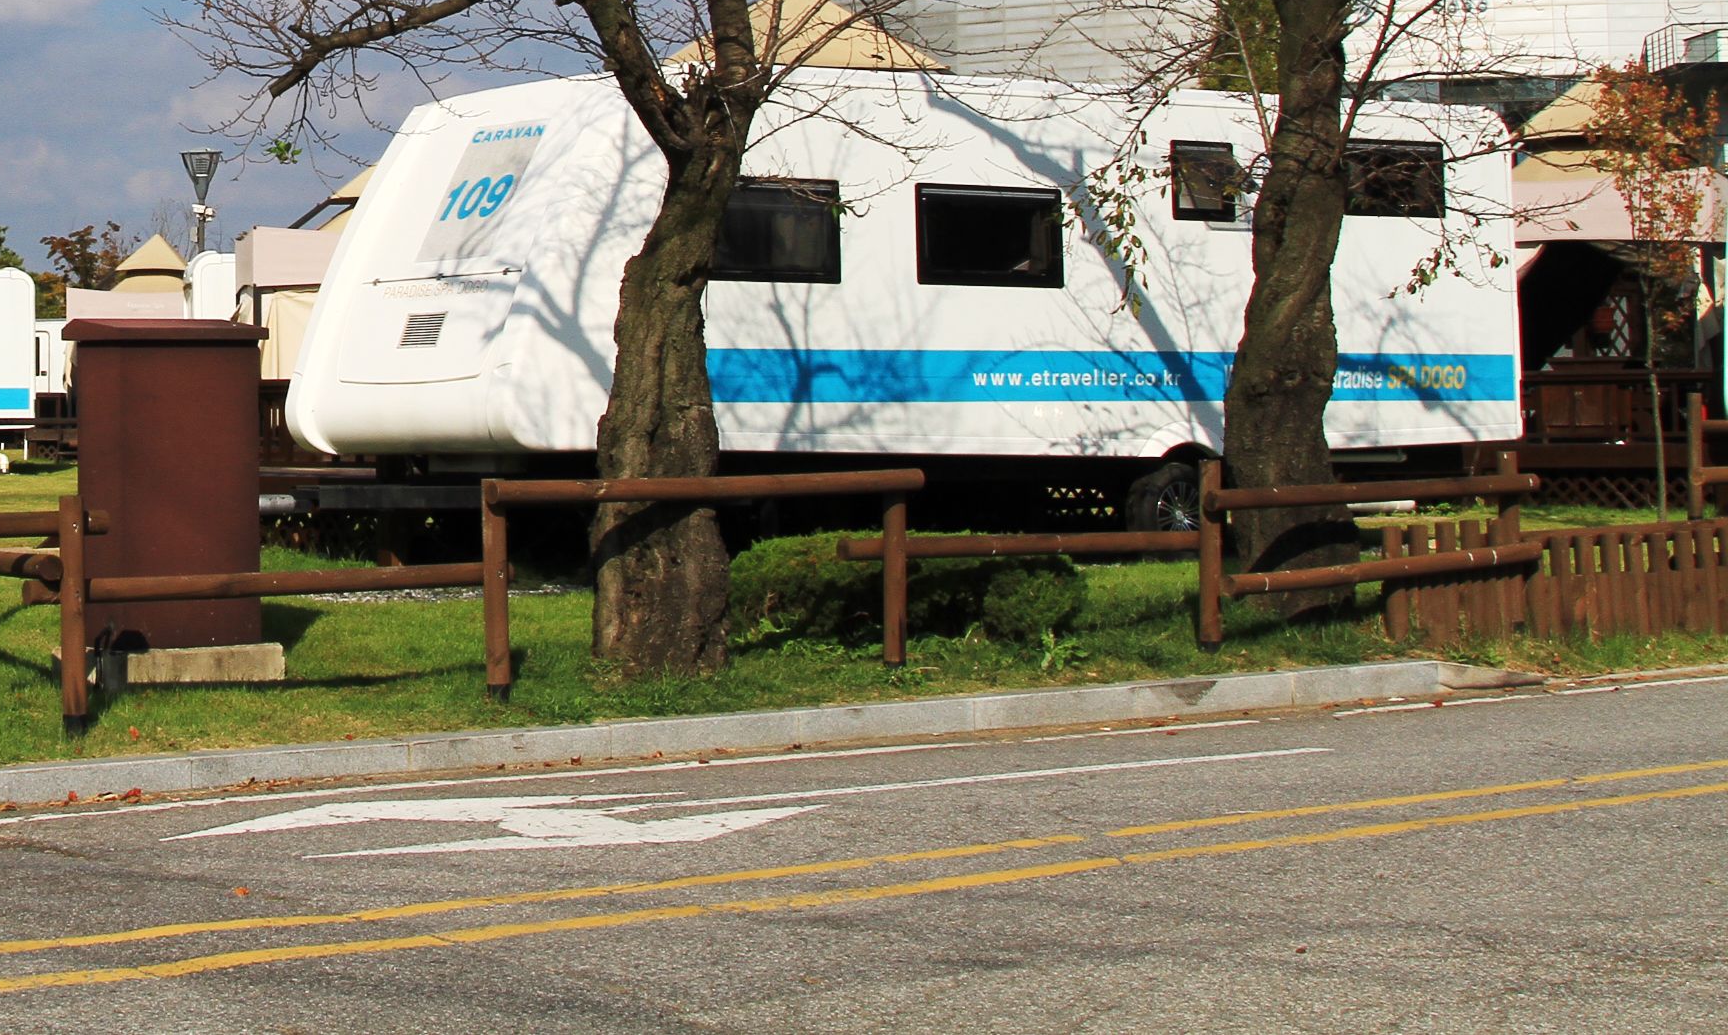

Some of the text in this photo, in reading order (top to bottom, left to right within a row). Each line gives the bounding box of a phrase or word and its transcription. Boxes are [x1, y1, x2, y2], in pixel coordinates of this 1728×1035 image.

[472, 124, 547, 143] CARAVAN
[439, 173, 515, 222] 109
[382, 280, 489, 300] PARADISE SPA DOGO
[973, 368, 1182, 386] www.etraveller.co.kr
[1387, 365, 1417, 389] SPA
[1420, 365, 1467, 390] DOGO
